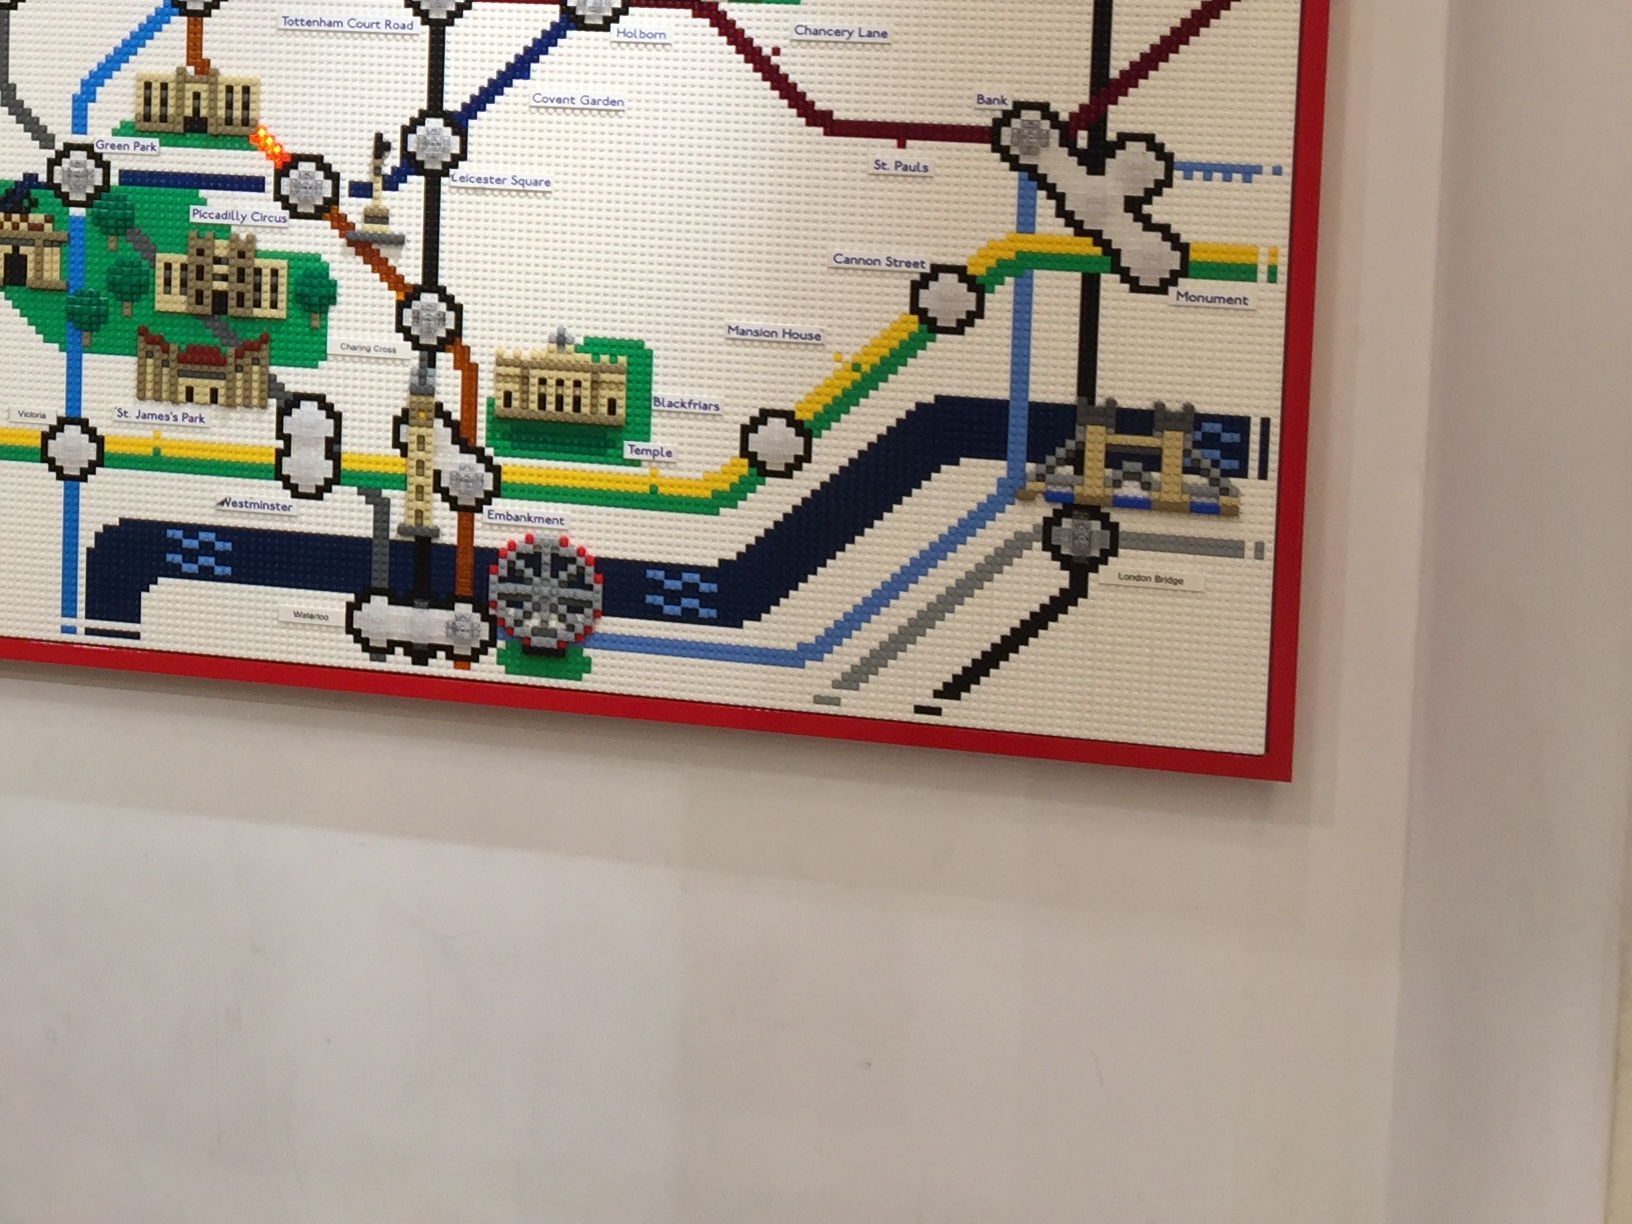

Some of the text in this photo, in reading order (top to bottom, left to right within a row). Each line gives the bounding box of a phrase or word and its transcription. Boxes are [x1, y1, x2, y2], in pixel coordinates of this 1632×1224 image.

[282, 17, 414, 31] Tottenham Court Road
[617, 27, 666, 40] Holborn
[794, 24, 888, 40] Chancery Lane
[533, 93, 624, 107] Covent Garden
[977, 94, 1007, 106] Bank
[95, 139, 157, 152] Green Park
[874, 160, 928, 173] St. Pauls
[451, 172, 551, 188] Leicester Square
[192, 209, 288, 224] Piccadilly Circus
[833, 254, 926, 269] Cannon Street
[1177, 291, 1249, 306] Monument
[728, 327, 822, 341] Mansion House
[340, 343, 396, 354] Charing Cross
[653, 396, 720, 411] Blackfriars
[18, 410, 46, 419] Victoria
[116, 408, 205, 424] St. James's Park
[628, 444, 673, 459] Temple
[487, 509, 565, 525] Embankment
[1118, 572, 1184, 586] London Bridge
[293, 611, 329, 621] Waterloo
